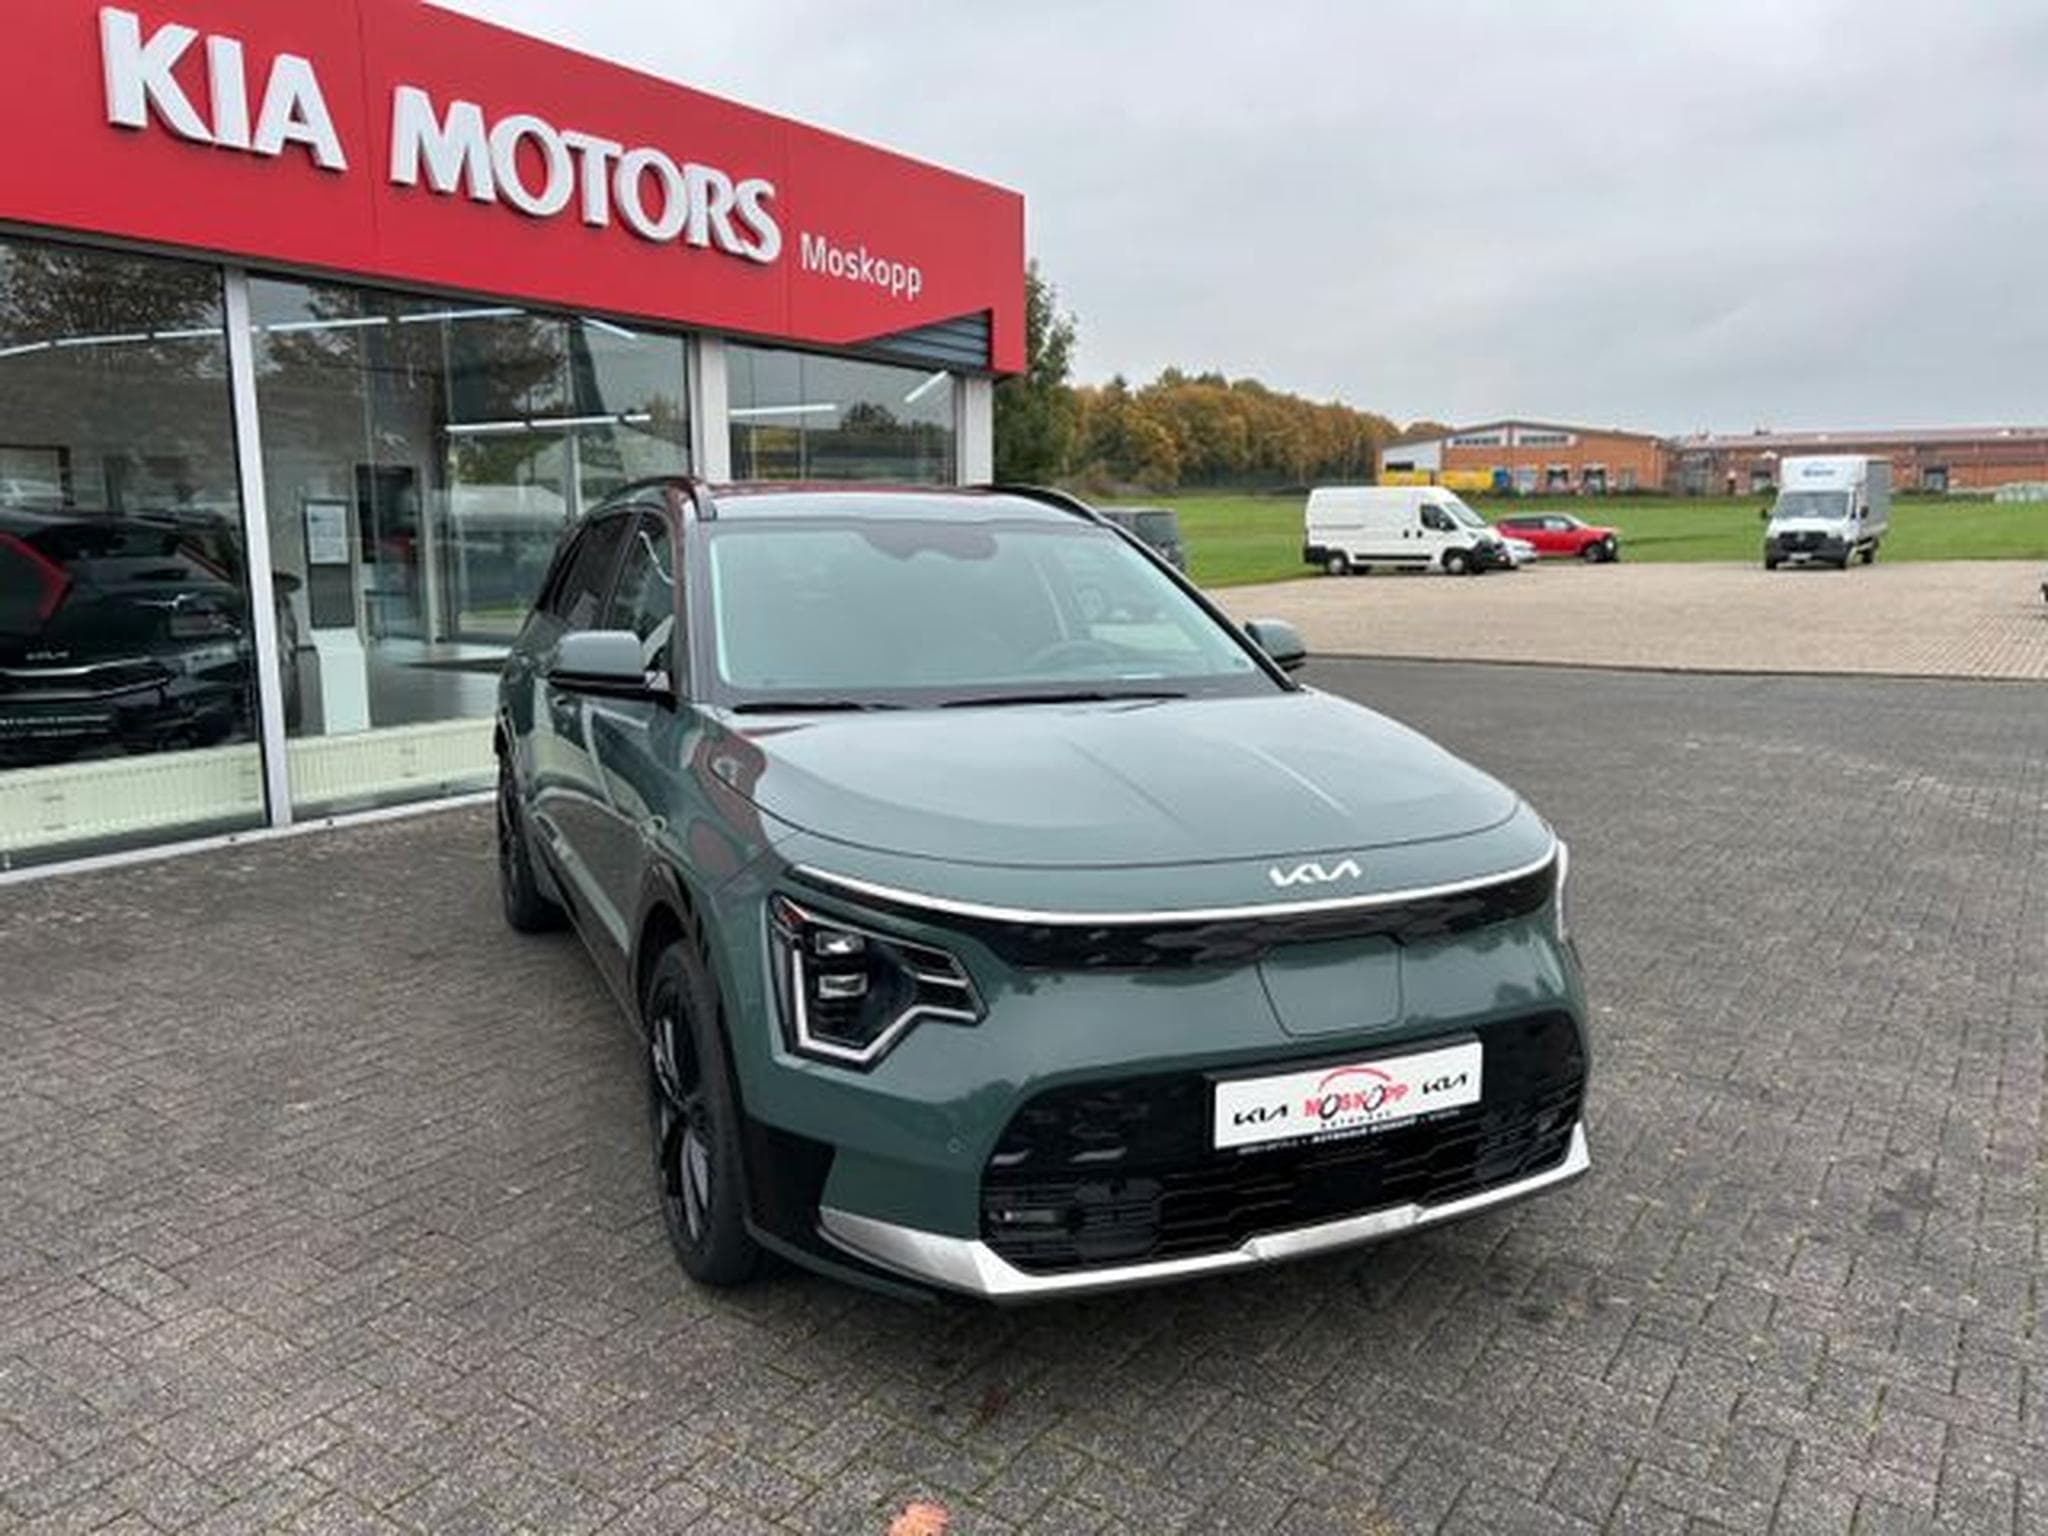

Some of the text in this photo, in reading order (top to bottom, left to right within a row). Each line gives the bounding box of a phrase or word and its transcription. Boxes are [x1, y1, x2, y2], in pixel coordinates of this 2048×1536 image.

[100, 6, 782, 264] KIA MOTORS
[801, 231, 922, 301] Moskopp
[1269, 859, 1362, 887] KIA
